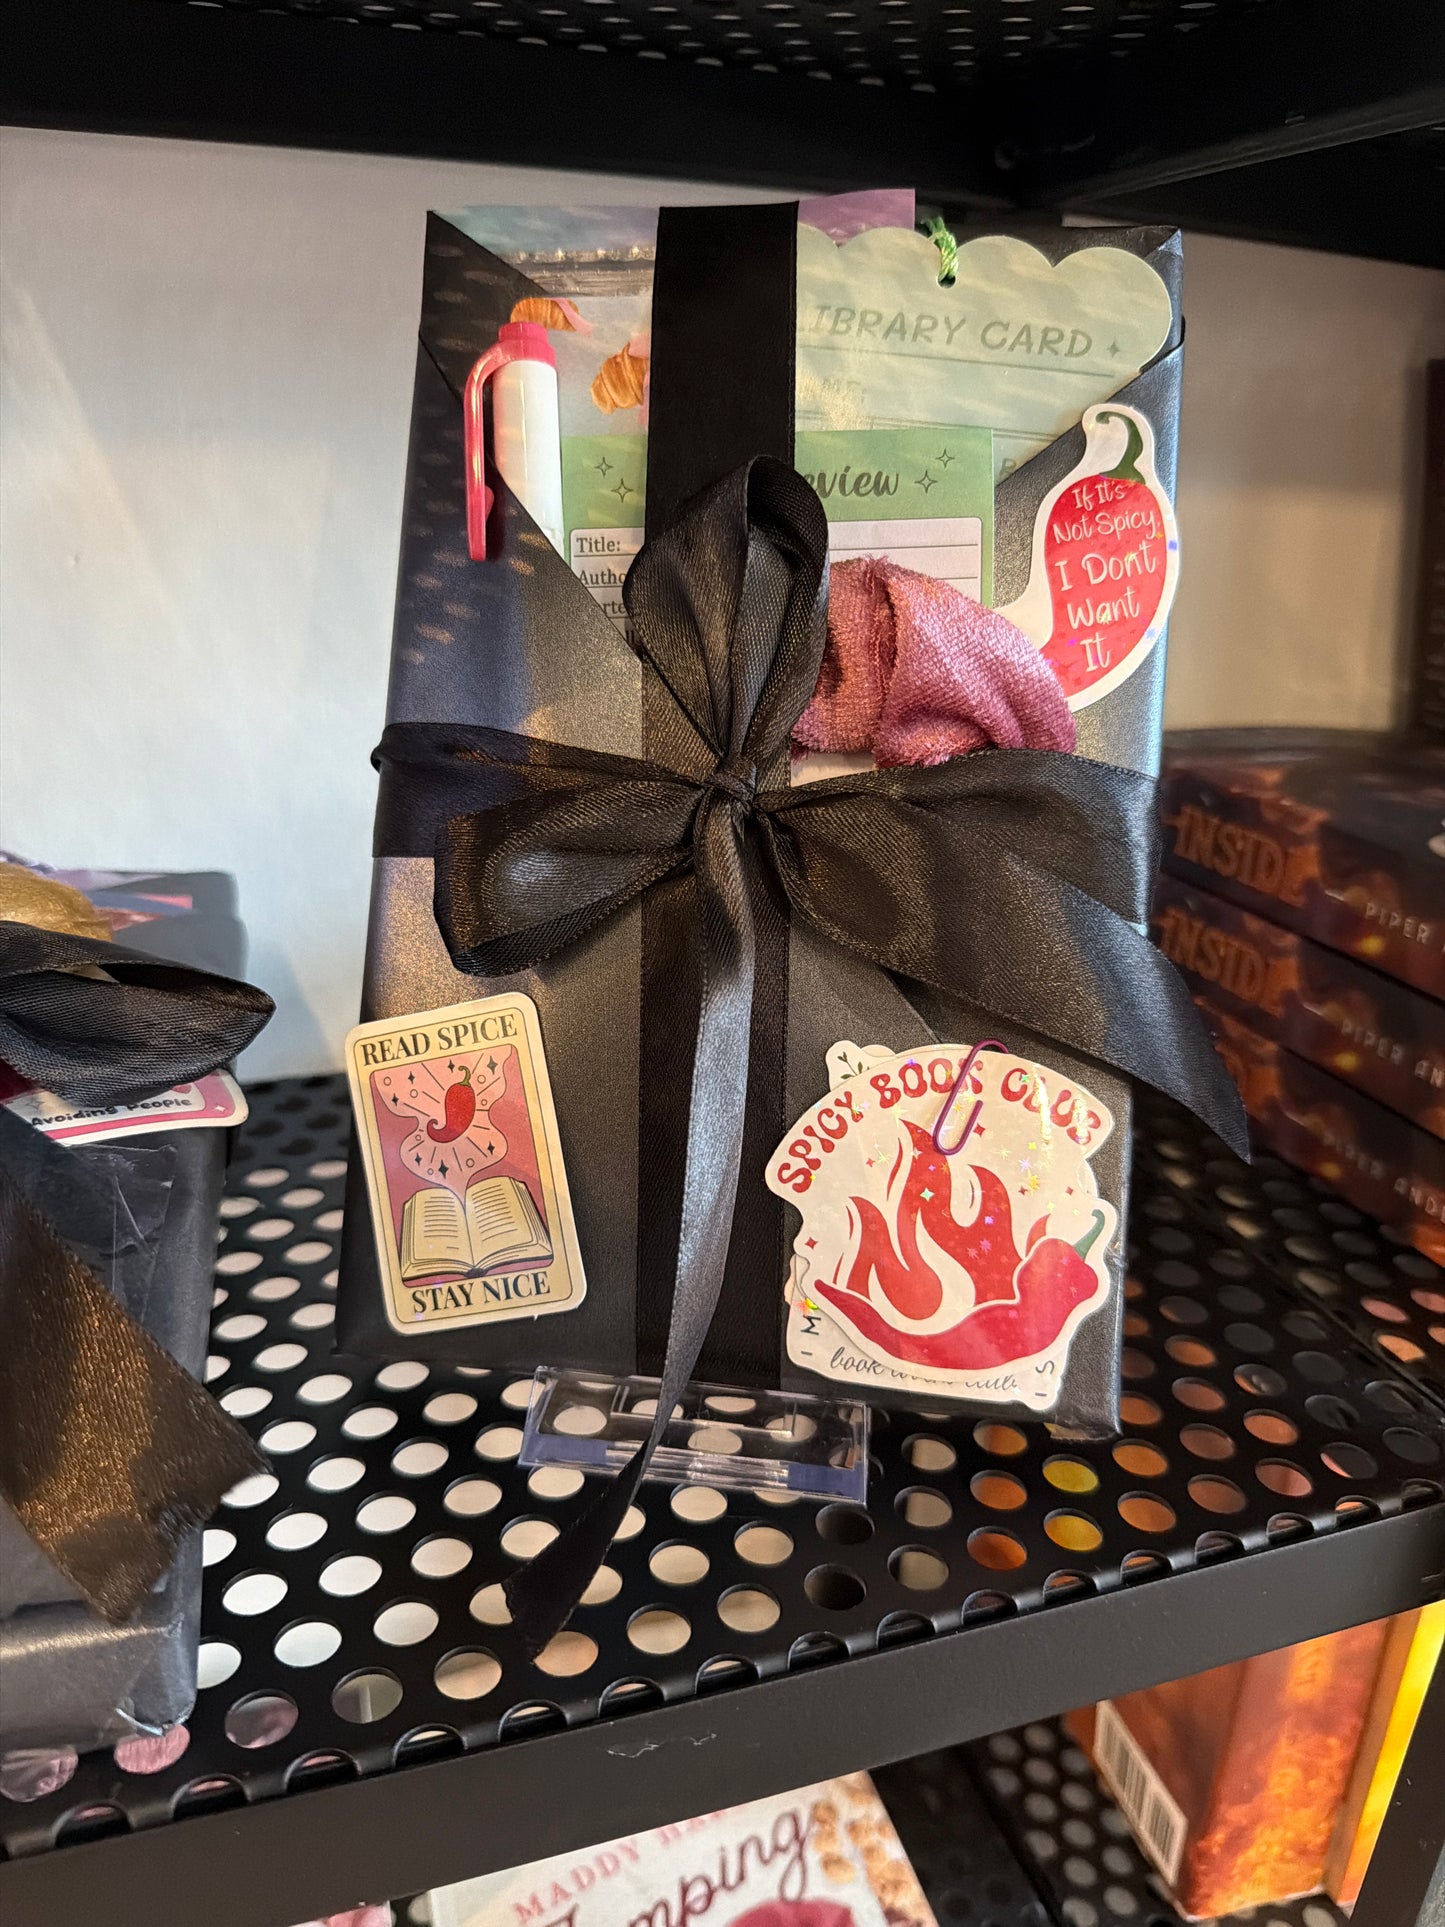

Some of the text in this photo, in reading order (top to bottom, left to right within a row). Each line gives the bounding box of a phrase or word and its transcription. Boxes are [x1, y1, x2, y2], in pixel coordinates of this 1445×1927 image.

[799, 305, 1093, 359] IBRARY CARD
[803, 466, 899, 498] eview
[1071, 479, 1127, 512] If It's
[576, 536, 621, 554] Title:
[1053, 516, 1093, 544] Not
[580, 568, 627, 586] Autho
[1055, 559, 1073, 591] I
[1067, 586, 1140, 630] Want
[1080, 632, 1110, 673] It
[1172, 803, 1304, 908] INSID
[1366, 902, 1431, 944] PIPER
[1158, 905, 1284, 1018] INSID
[361, 1013, 518, 1067] READ SPICE
[31, 1105, 119, 1126] Avoiding
[777, 1090, 864, 1193] SPICY
[869, 1057, 983, 1109] BOOK
[412, 1270, 551, 1314] STAY NICE
[513, 1838, 639, 1922] MADDY
